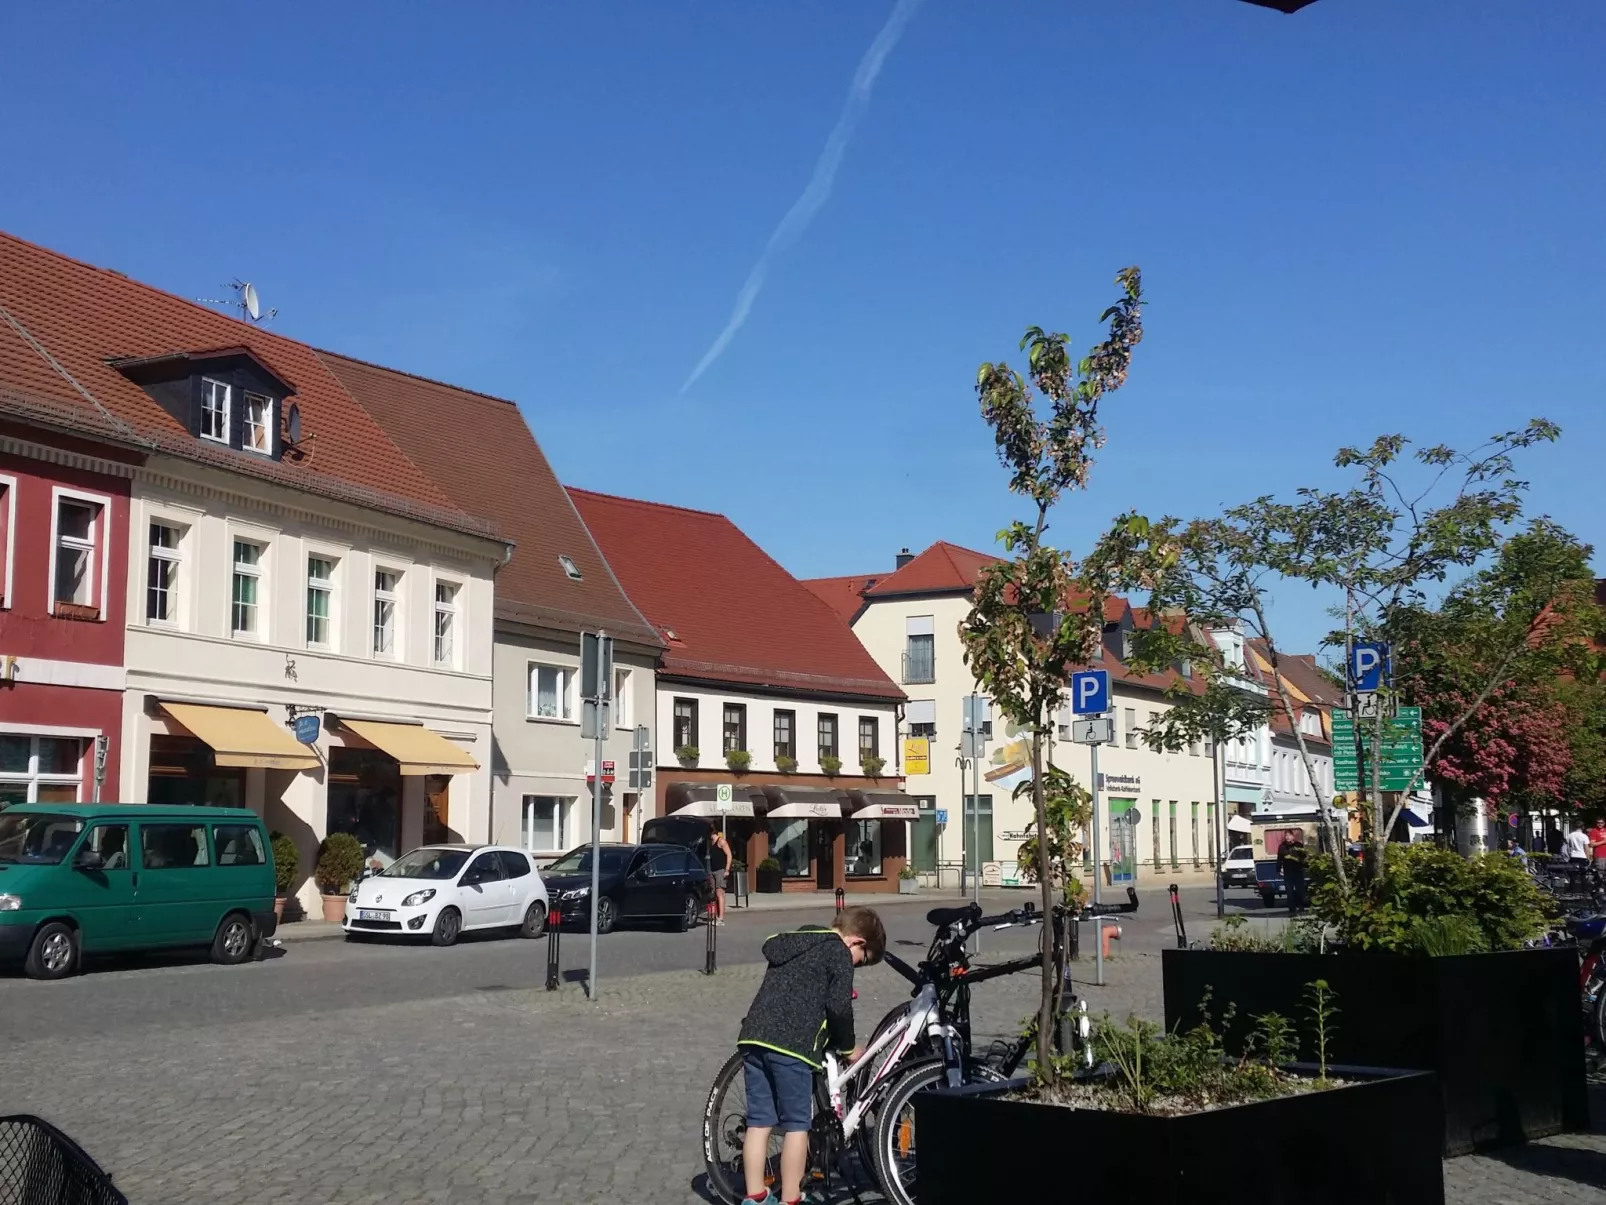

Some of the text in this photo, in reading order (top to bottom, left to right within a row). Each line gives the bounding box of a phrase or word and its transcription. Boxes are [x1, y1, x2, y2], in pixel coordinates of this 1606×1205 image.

[1356, 649, 1381, 684] P
[1080, 677, 1100, 709] P
[704, 1121, 710, 1137] OF
[705, 1141, 713, 1163] ACE
